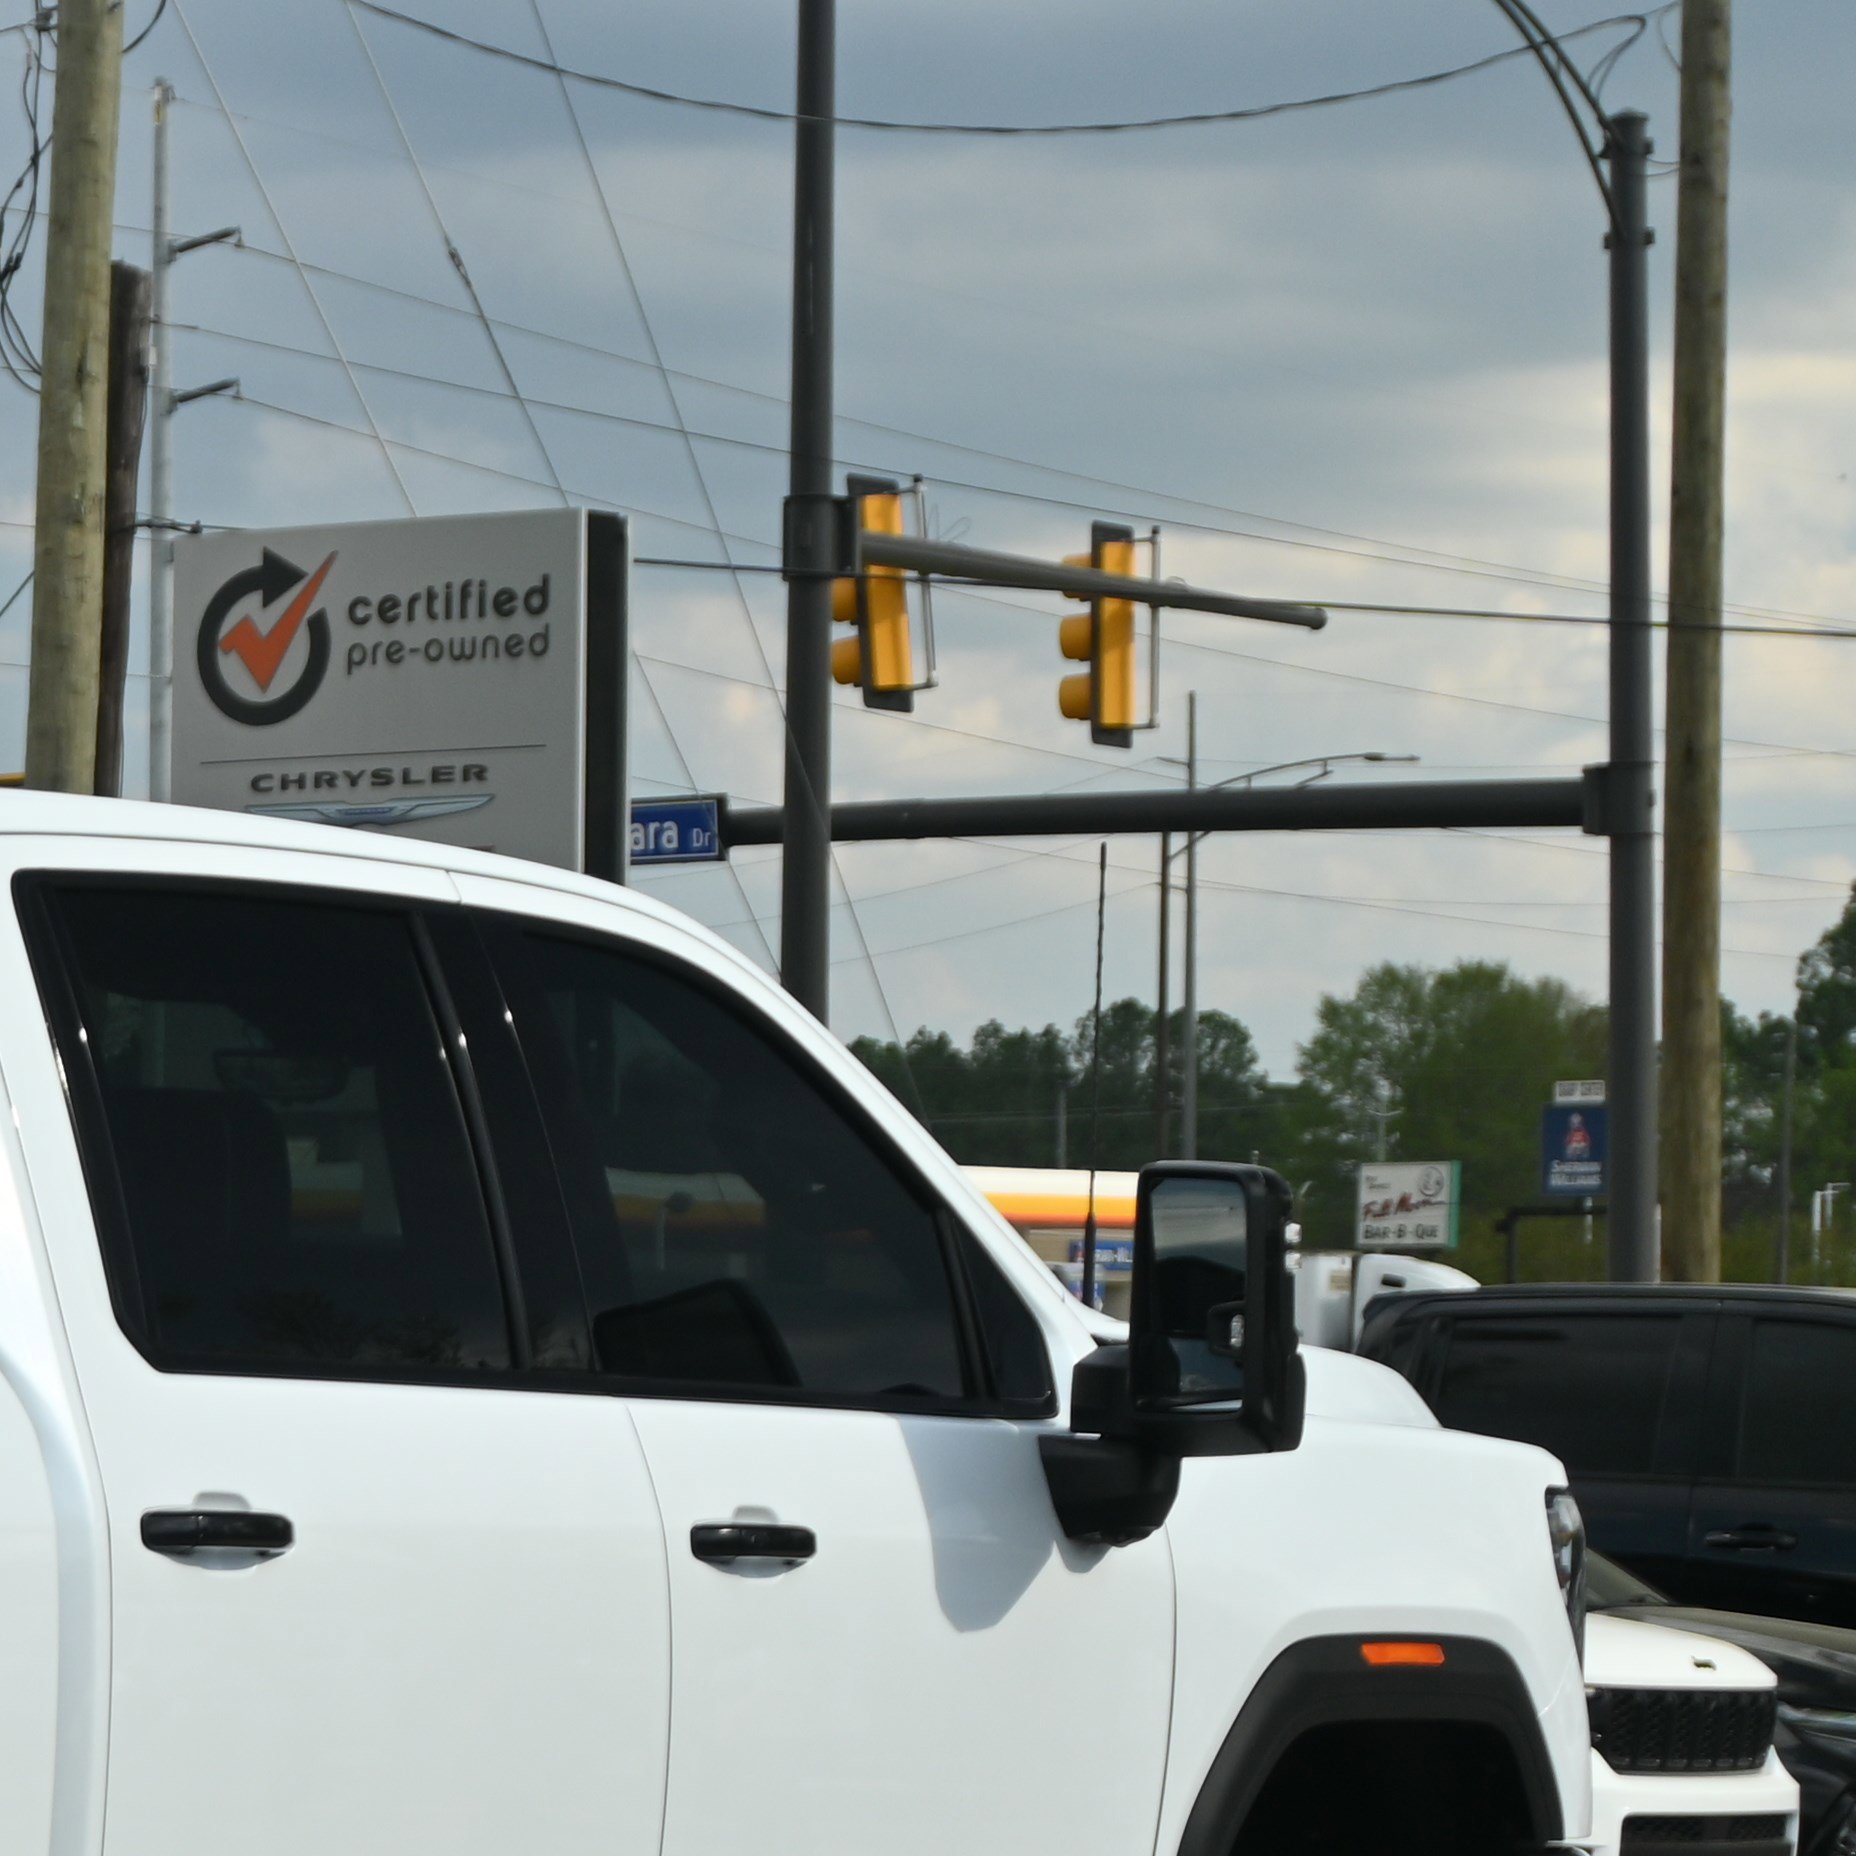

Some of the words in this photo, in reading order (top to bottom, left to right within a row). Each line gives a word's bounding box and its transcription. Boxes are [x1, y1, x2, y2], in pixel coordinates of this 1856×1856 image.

[348, 573, 550, 625] certified
[347, 622, 550, 676] pre-owned
[250, 763, 488, 793] CHRYSLER
[693, 827, 711, 848] Dr
